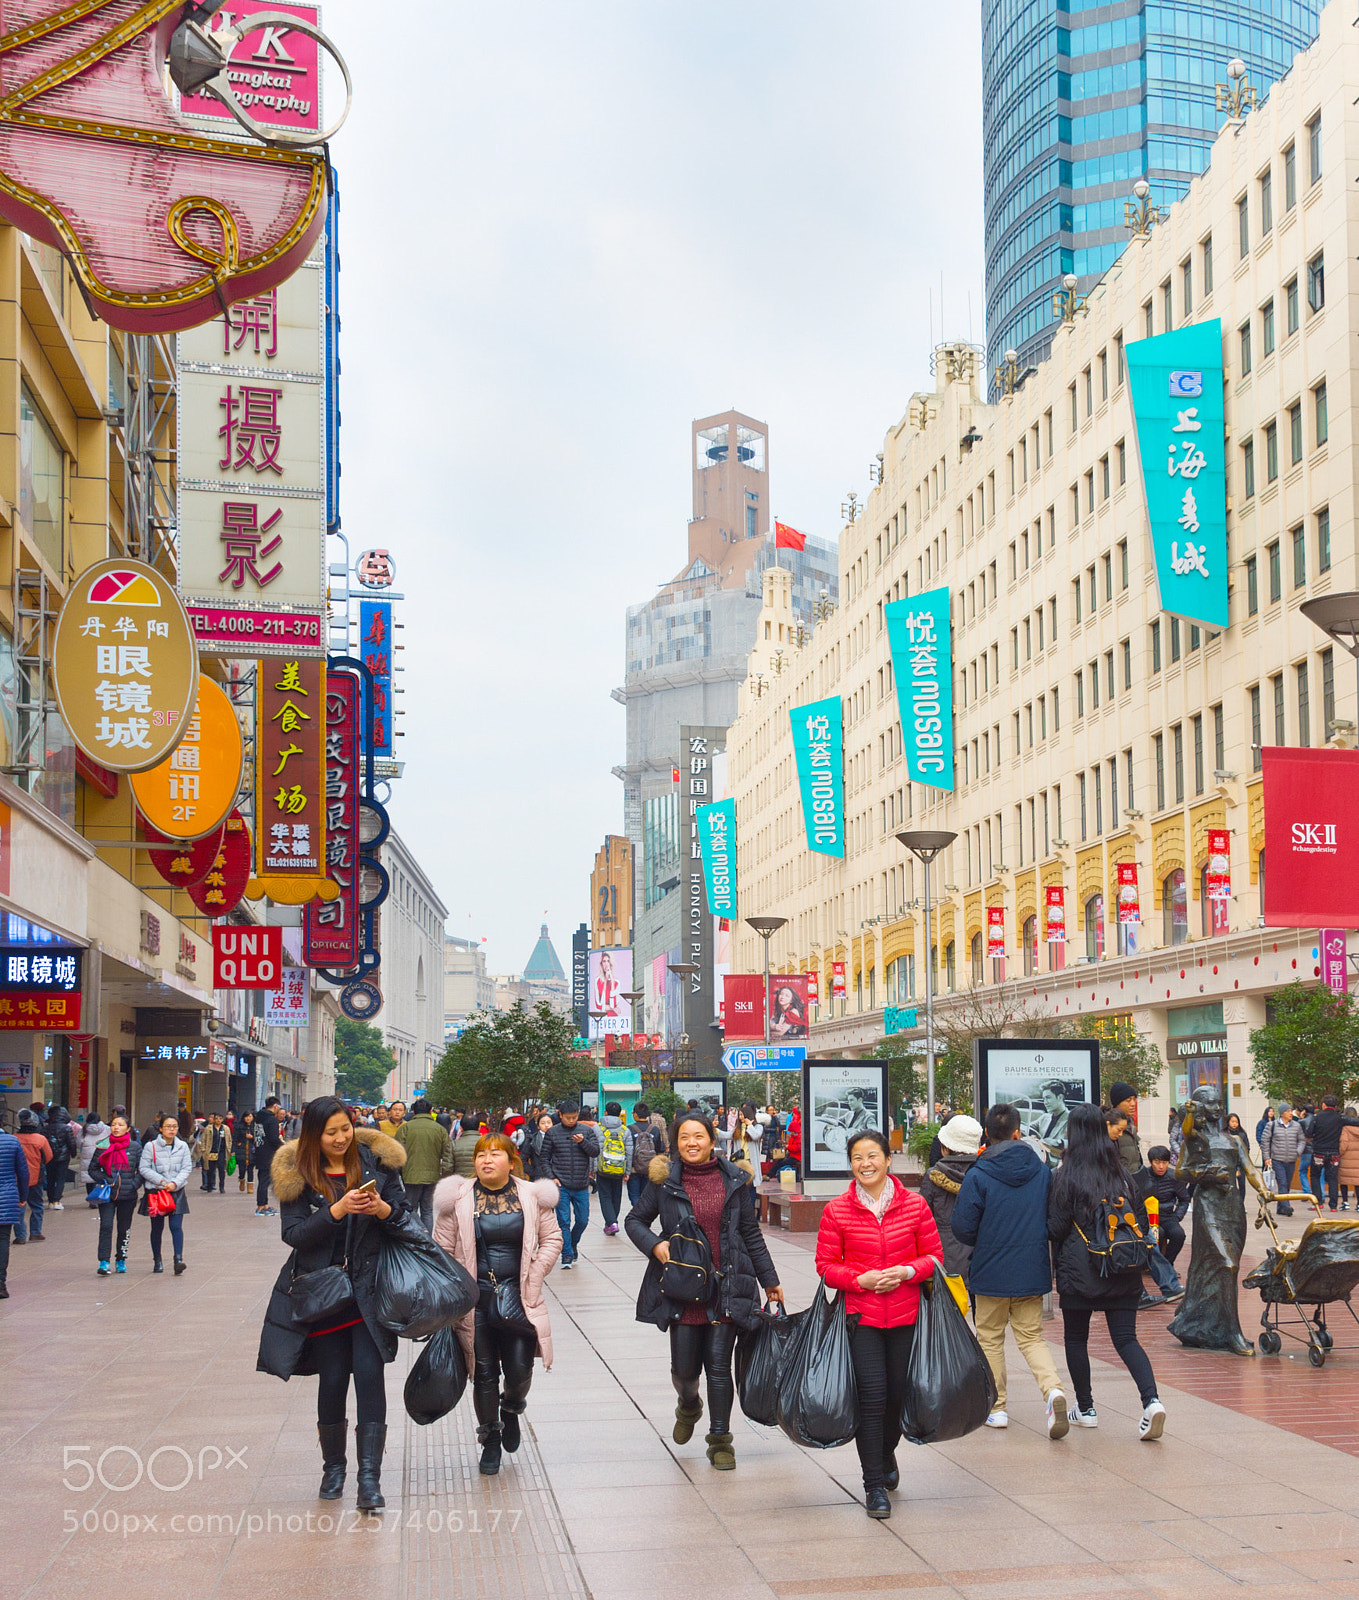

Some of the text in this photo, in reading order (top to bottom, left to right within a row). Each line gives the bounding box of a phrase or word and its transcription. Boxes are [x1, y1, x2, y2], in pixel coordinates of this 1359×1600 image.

[226, 70, 292, 90] angkai
[79, 616, 169, 640] 丹华阳
[95, 645, 153, 750] 眼镜城
[152, 710, 180, 726] 3F
[272, 660, 311, 814] 美食广场
[172, 806, 197, 821] 2F
[1291, 823, 1337, 845] SK-II
[599, 885, 616, 916] 21
[691, 873, 700, 935] HONGYI
[220, 933, 269, 955] UNI
[311, 940, 350, 950] OPTICAL
[8, 956, 76, 983] 眼镜城
[220, 959, 274, 985] QLO
[574, 950, 585, 1007] FOREVER 21
[620, 1018, 629, 1029] 21
[141, 1046, 207, 1060] 上海特产
[1177, 1042, 1198, 1055] POLO
